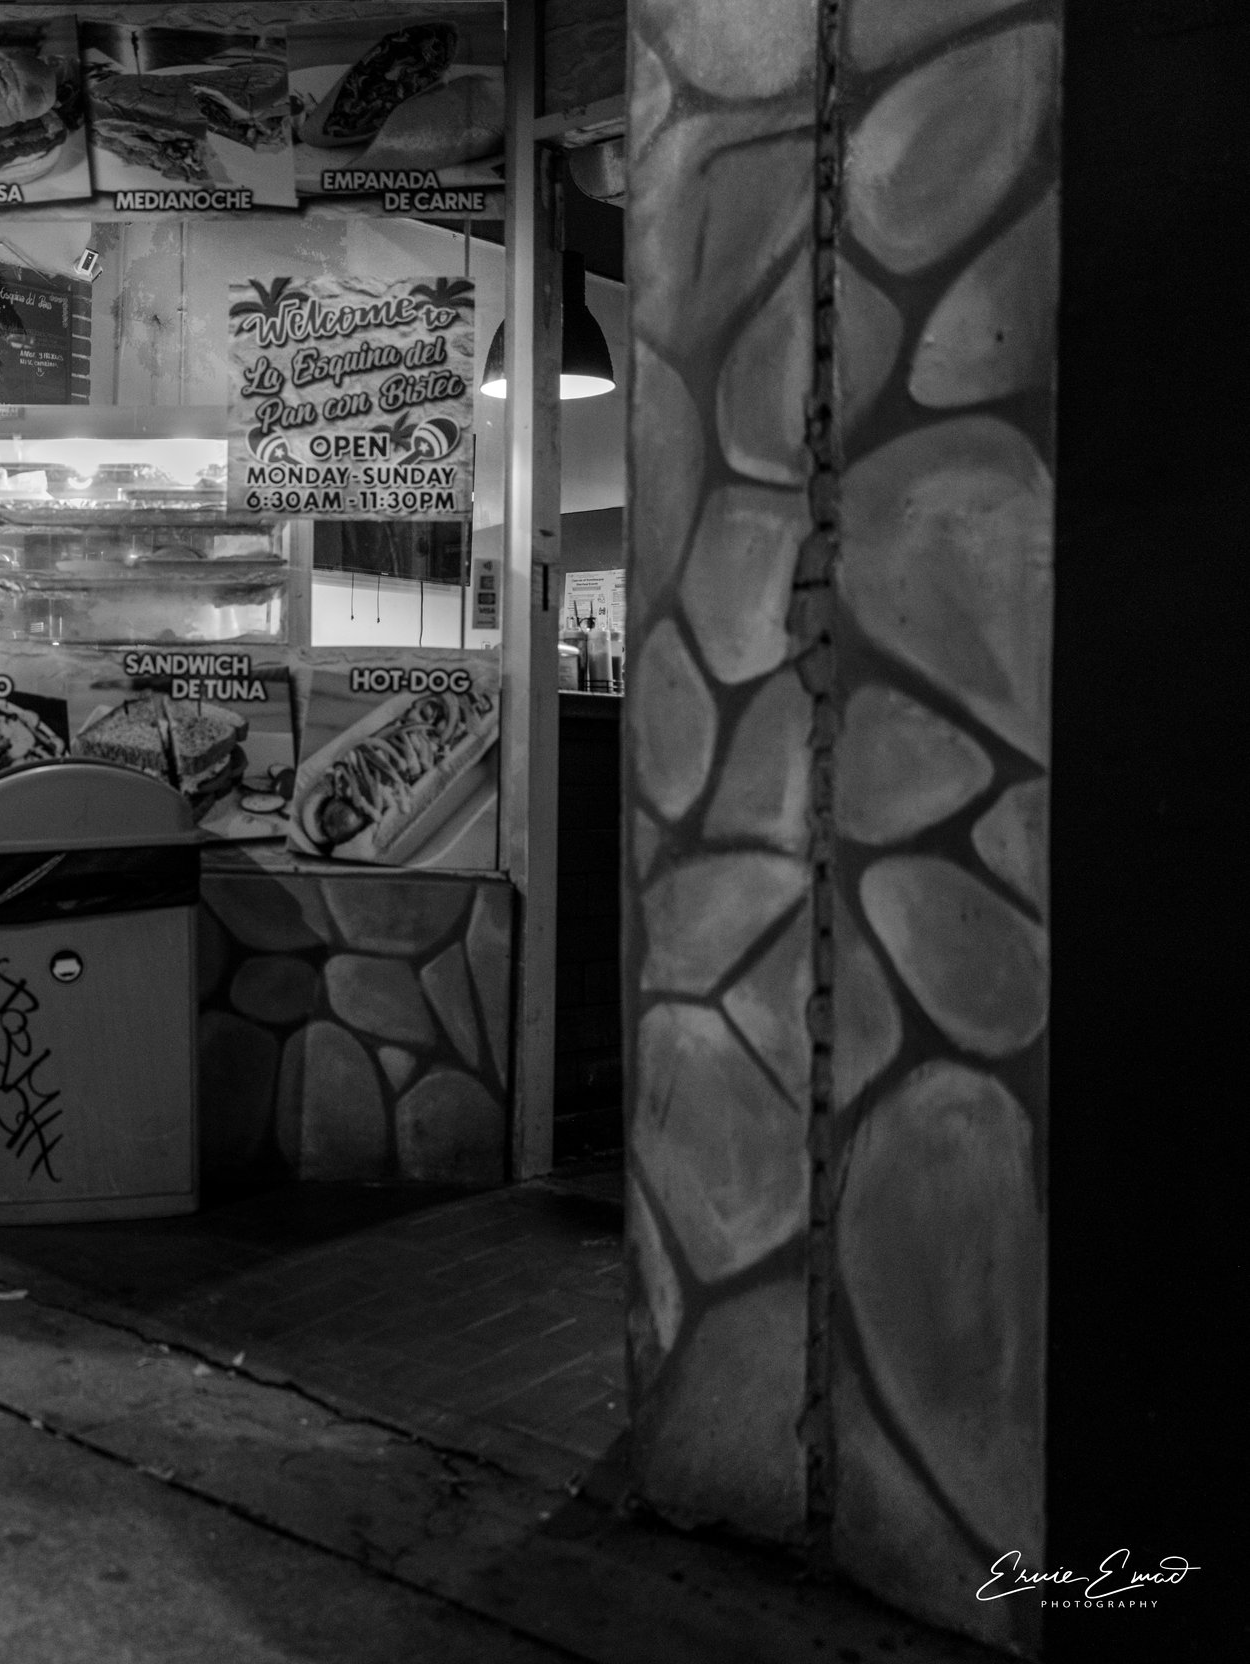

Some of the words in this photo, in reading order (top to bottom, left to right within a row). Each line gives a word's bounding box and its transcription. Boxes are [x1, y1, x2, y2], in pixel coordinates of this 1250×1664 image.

[322, 170, 439, 192] EMPANADA
[115, 189, 252, 211] MEDIANOCHE
[383, 191, 411, 212] DE
[413, 191, 485, 212] CARNE
[243, 298, 418, 347] Welcome
[421, 305, 456, 331] to
[241, 354, 285, 397] La
[291, 341, 401, 388] Esquina
[402, 335, 447, 369] del
[256, 397, 317, 434] Pan
[322, 391, 373, 421] con
[378, 368, 466, 412] Bistec
[309, 435, 389, 459] OPEN
[246, 491, 343, 510] 6:30AM
[359, 491, 455, 510] 11:30PM
[124, 652, 249, 678] SANDWICH
[171, 678, 202, 700] DE
[203, 677, 267, 701] TUNA
[351, 668, 471, 695] HOT-DOG
